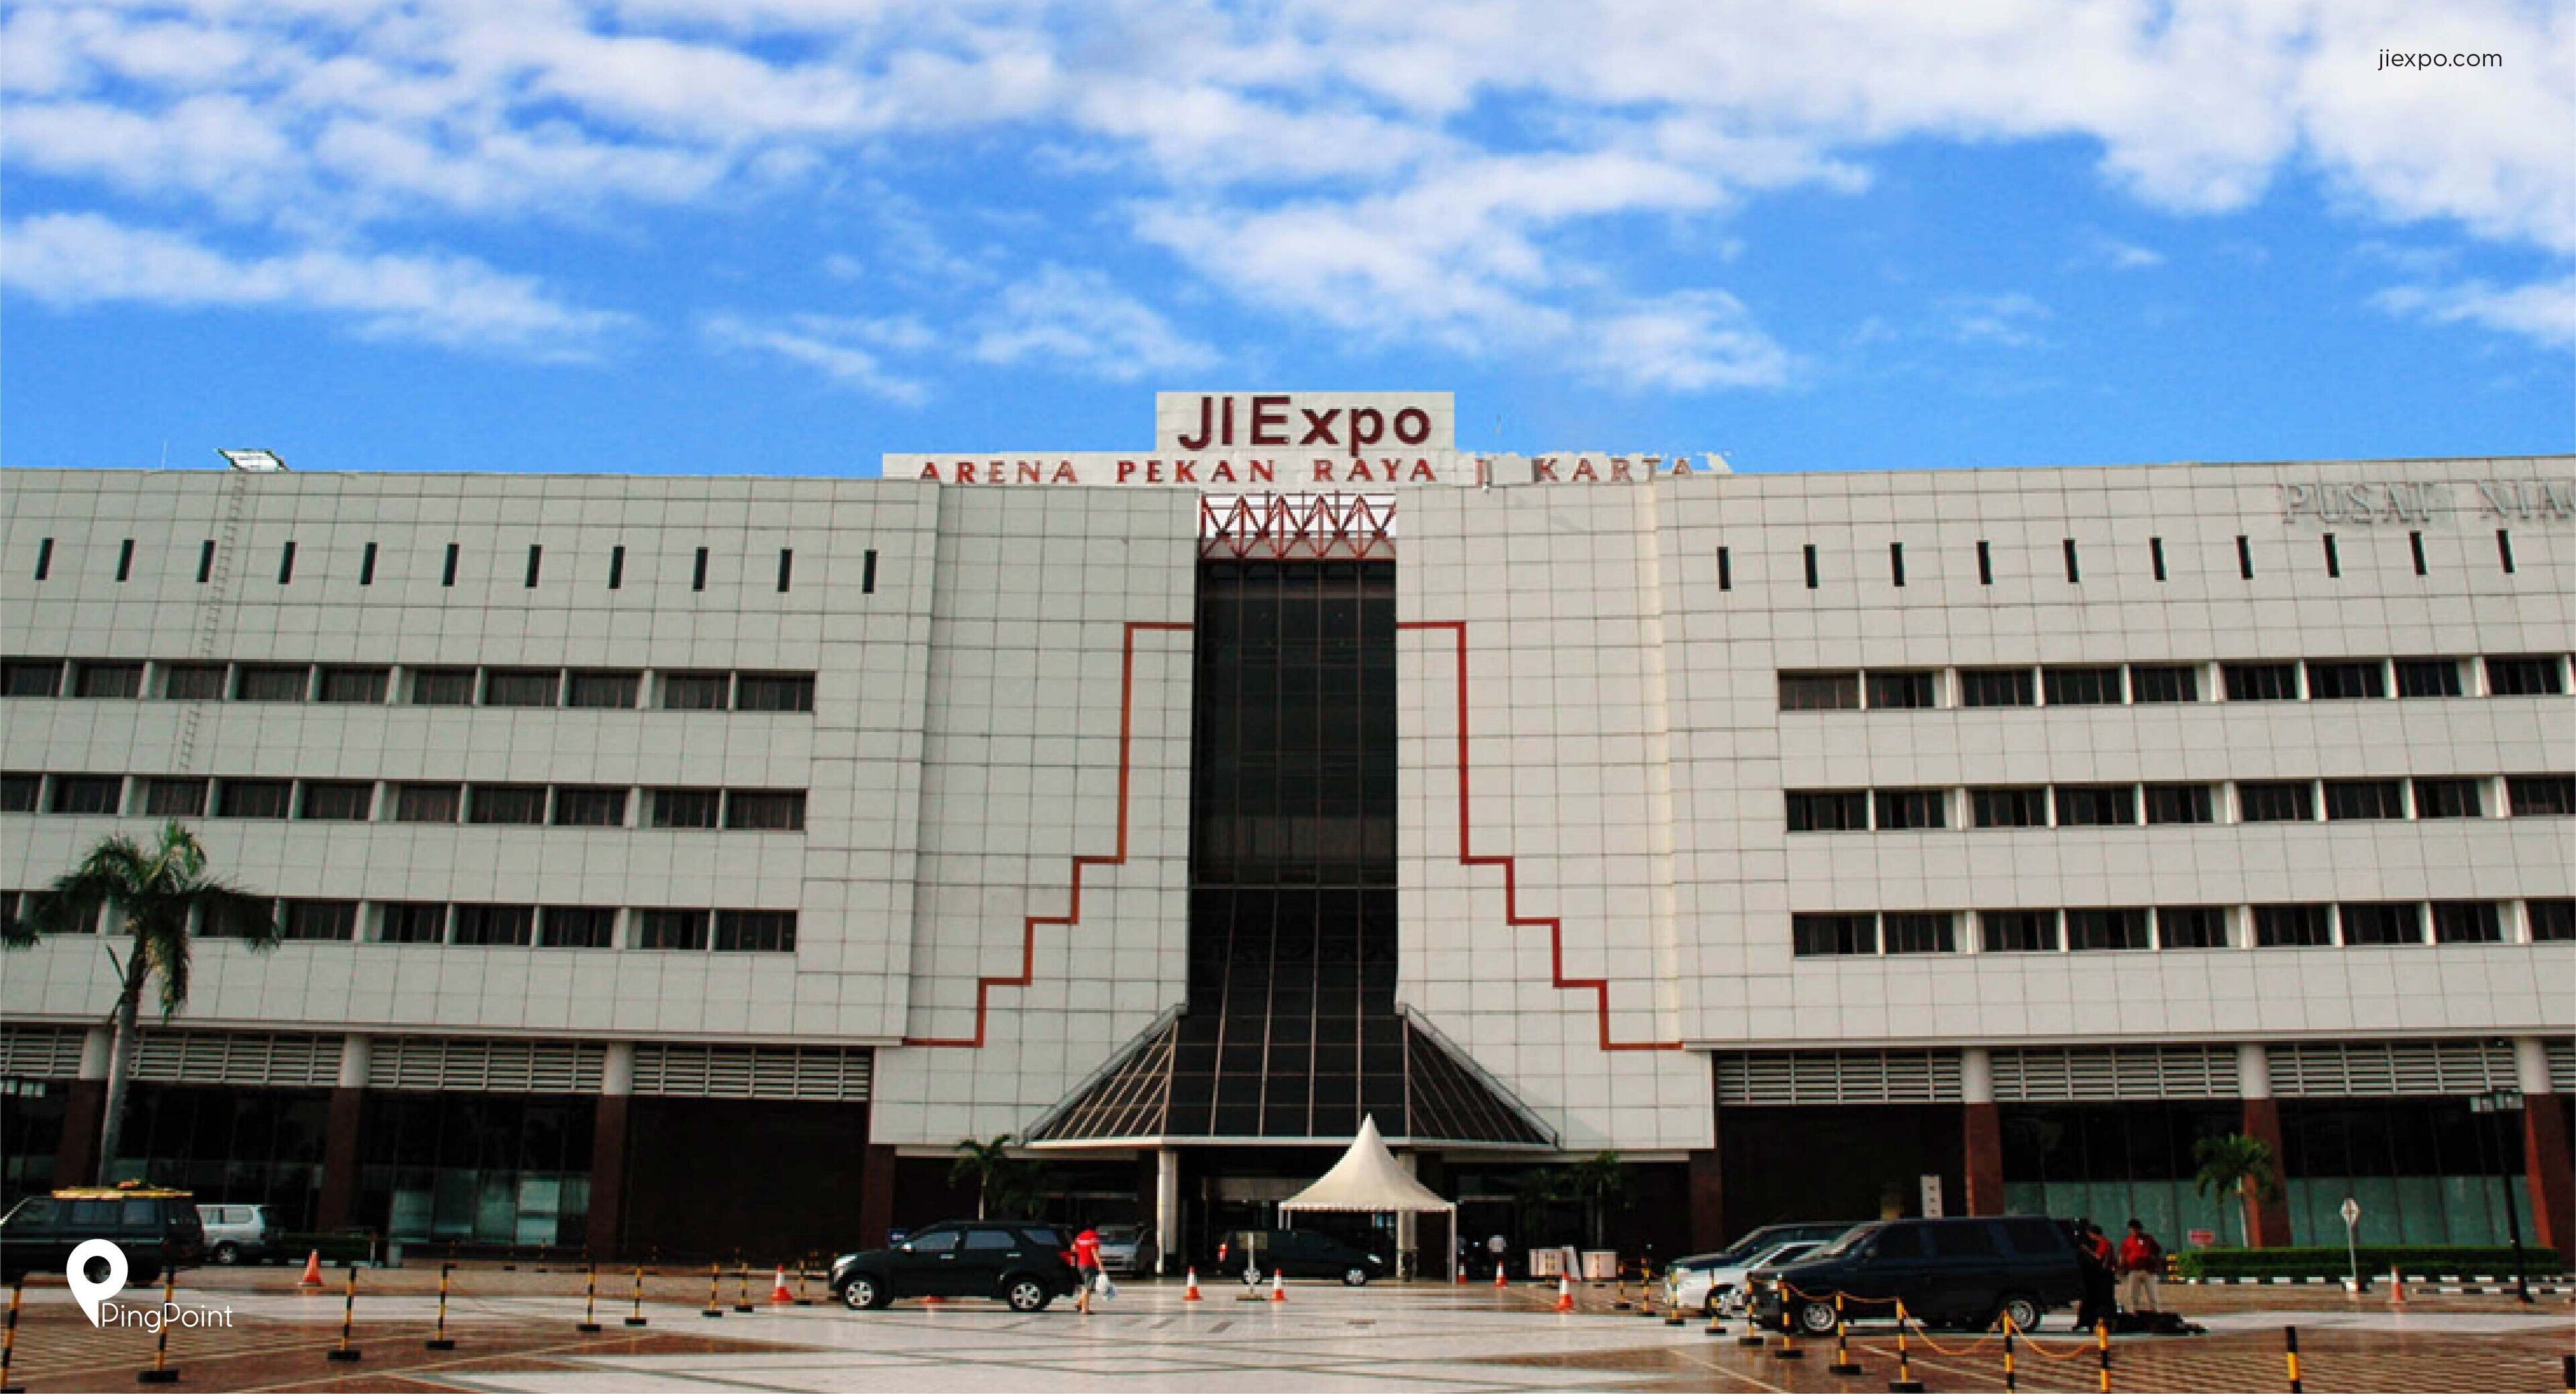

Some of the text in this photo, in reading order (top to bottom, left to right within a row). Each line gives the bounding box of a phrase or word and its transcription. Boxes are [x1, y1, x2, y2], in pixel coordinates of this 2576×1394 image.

[920, 460, 1079, 484] ARENA
[1116, 460, 1276, 483] PEKAN
[1313, 458, 1437, 482] RAYA
[2281, 480, 2440, 525] PUSAT
